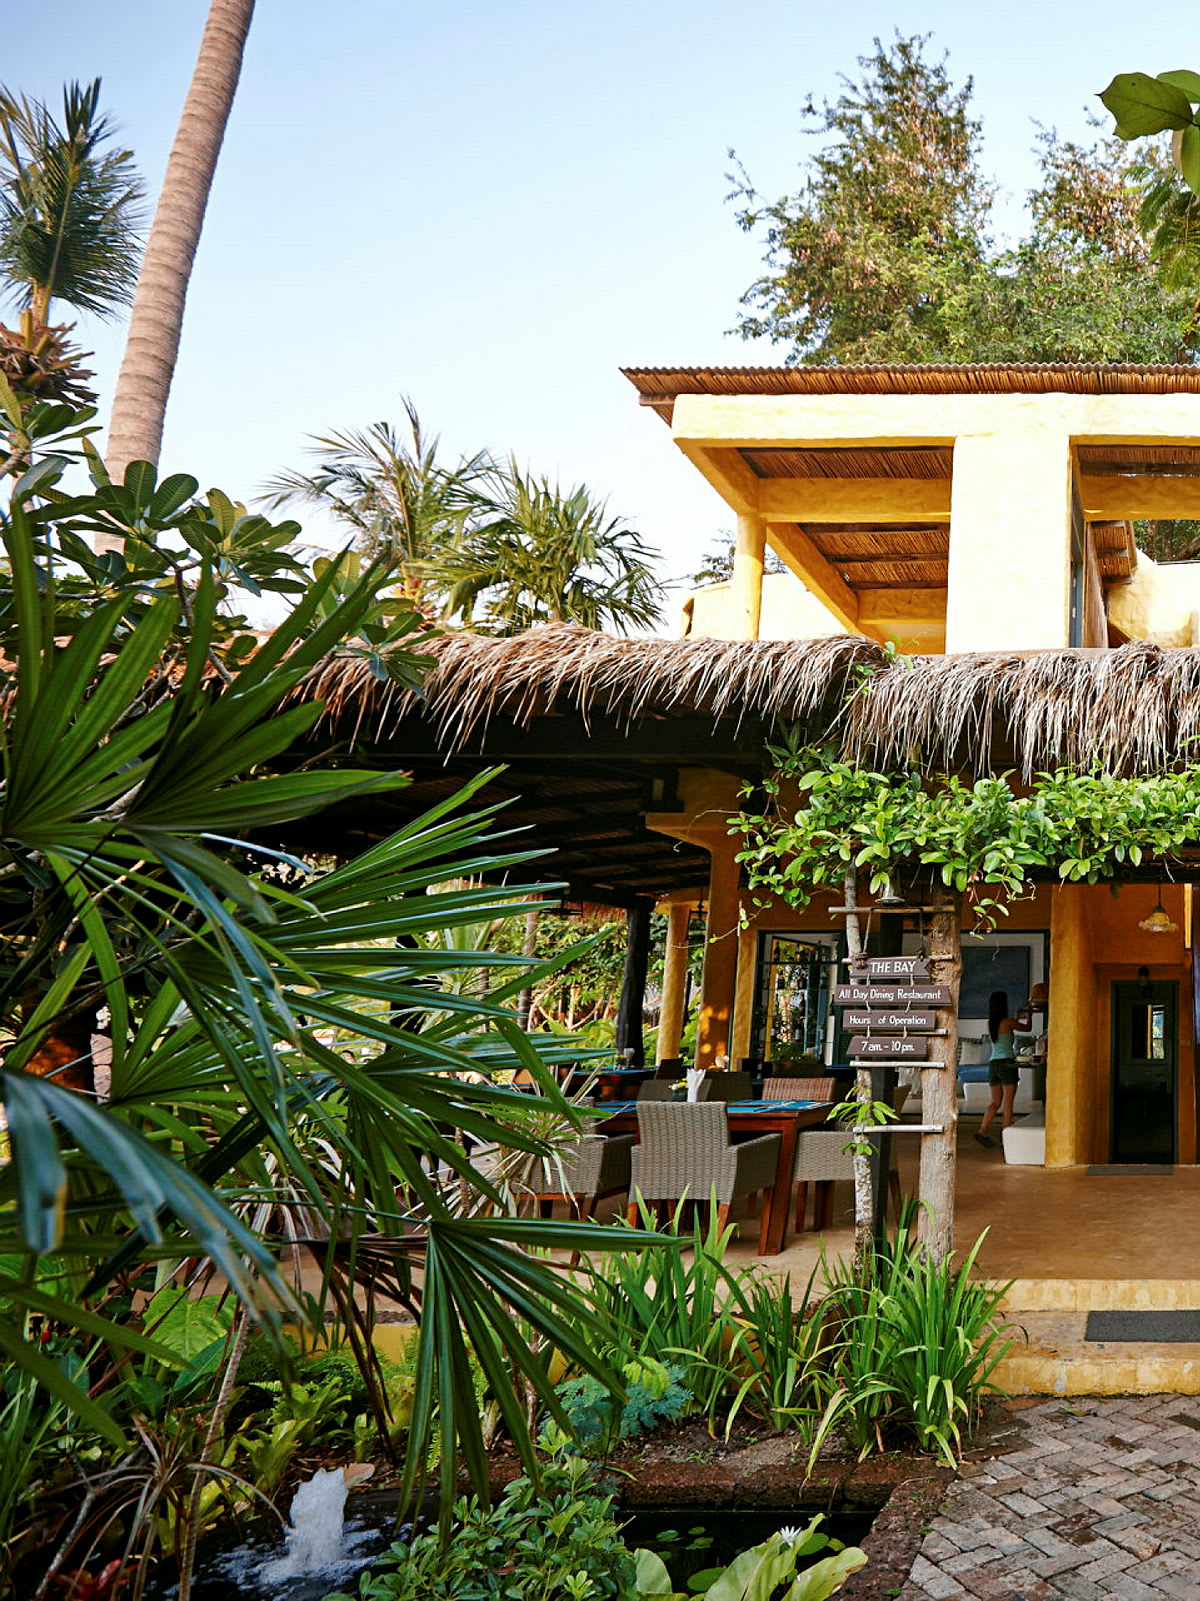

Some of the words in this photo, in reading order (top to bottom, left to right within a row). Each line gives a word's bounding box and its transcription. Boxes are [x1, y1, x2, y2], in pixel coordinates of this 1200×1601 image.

[870, 962, 891, 973] THE
[894, 961, 916, 973] BAY
[839, 989, 851, 999] All
[853, 989, 867, 1000] Day
[870, 989, 894, 1001] Dining
[897, 989, 941, 999] Restaurant
[849, 1015, 870, 1025] Hours
[878, 1016, 886, 1025] of
[889, 1015, 926, 1025] Operation
